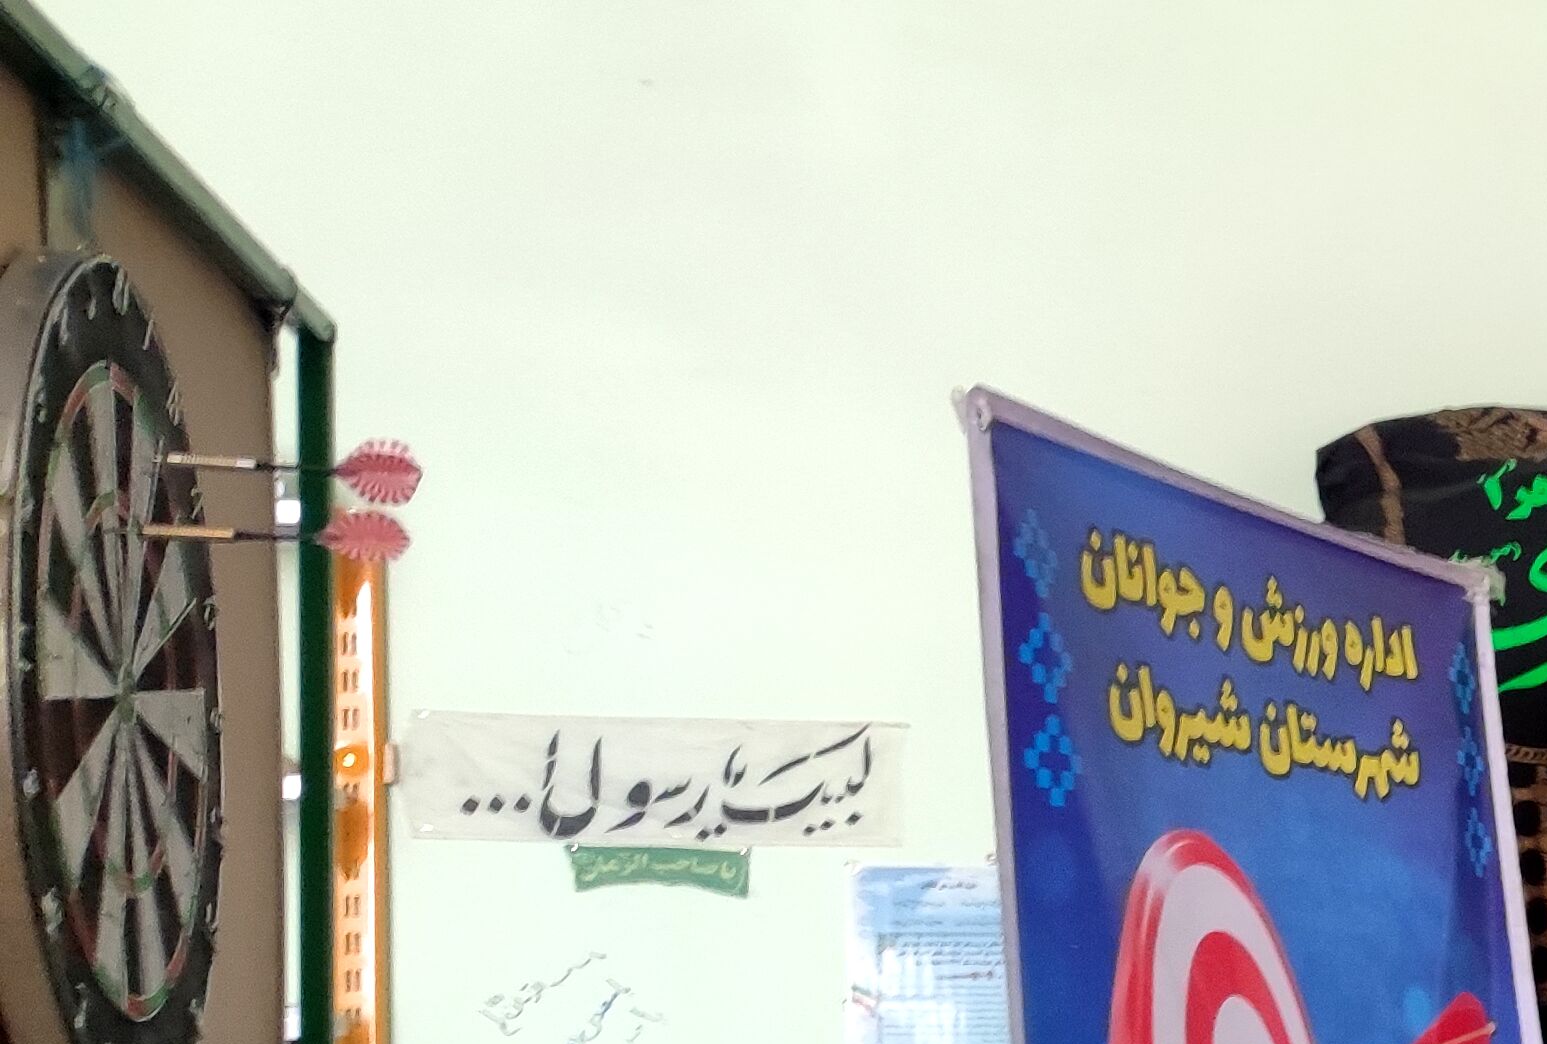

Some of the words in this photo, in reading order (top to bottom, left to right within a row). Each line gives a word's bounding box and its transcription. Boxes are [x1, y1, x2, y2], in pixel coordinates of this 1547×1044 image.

[1080, 527, 1206, 640] جوانان
[1213, 585, 1234, 651] و
[1241, 576, 1338, 680] ورزش
[1344, 614, 1418, 691] اداره
[1108, 663, 1252, 765] شیروان
[1259, 703, 1421, 801] شهرستان
